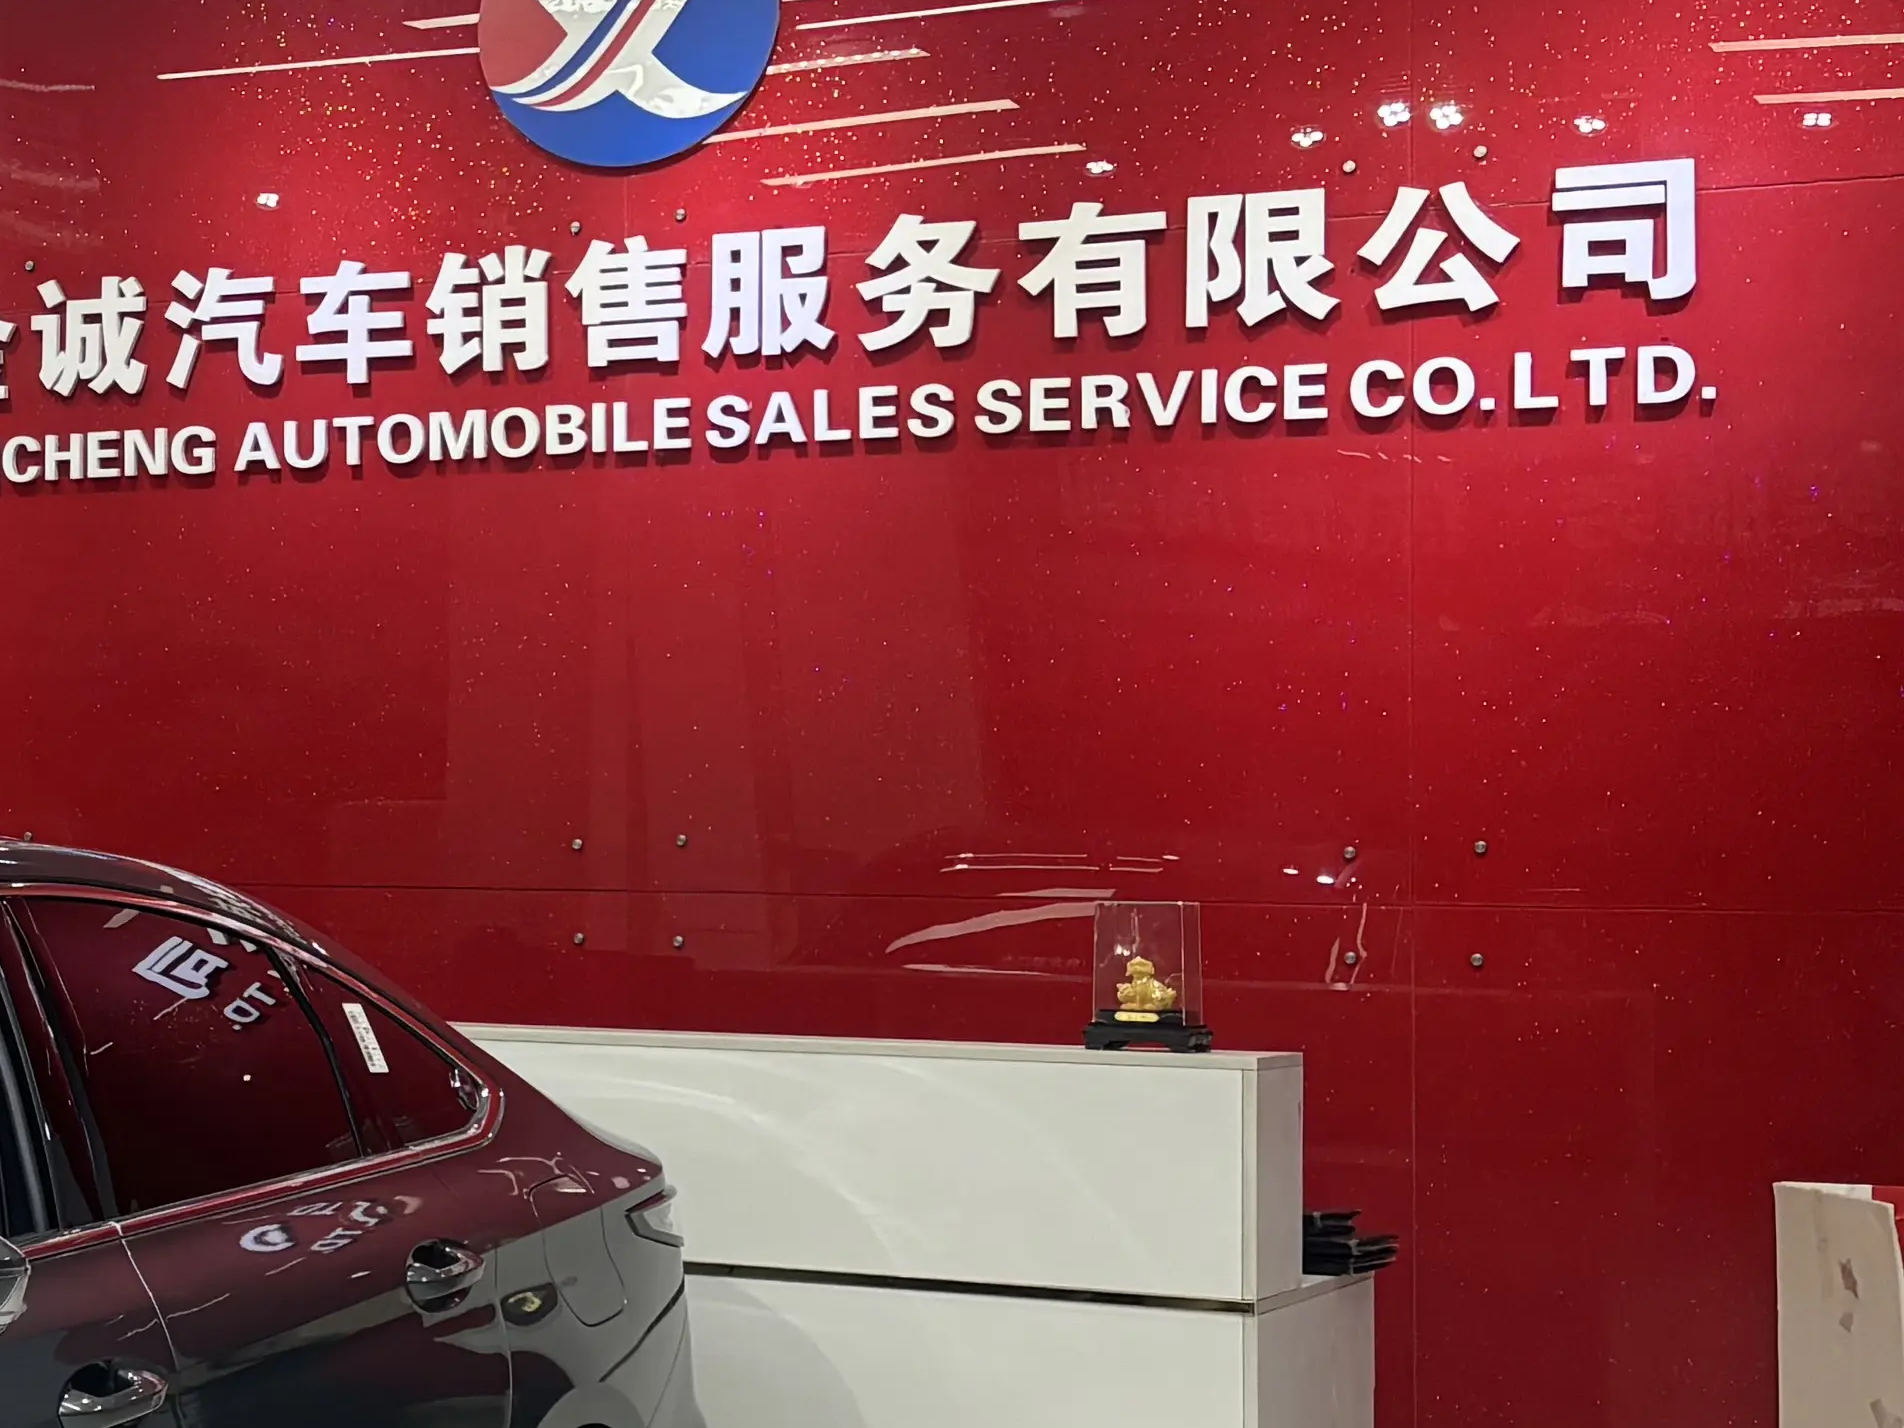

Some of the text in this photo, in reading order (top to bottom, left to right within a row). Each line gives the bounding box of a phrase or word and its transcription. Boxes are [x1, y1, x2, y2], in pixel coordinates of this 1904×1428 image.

[233, 395, 692, 473] AUTOMOBILE
[704, 382, 956, 449] SALES
[973, 362, 1330, 436] SERVICE
